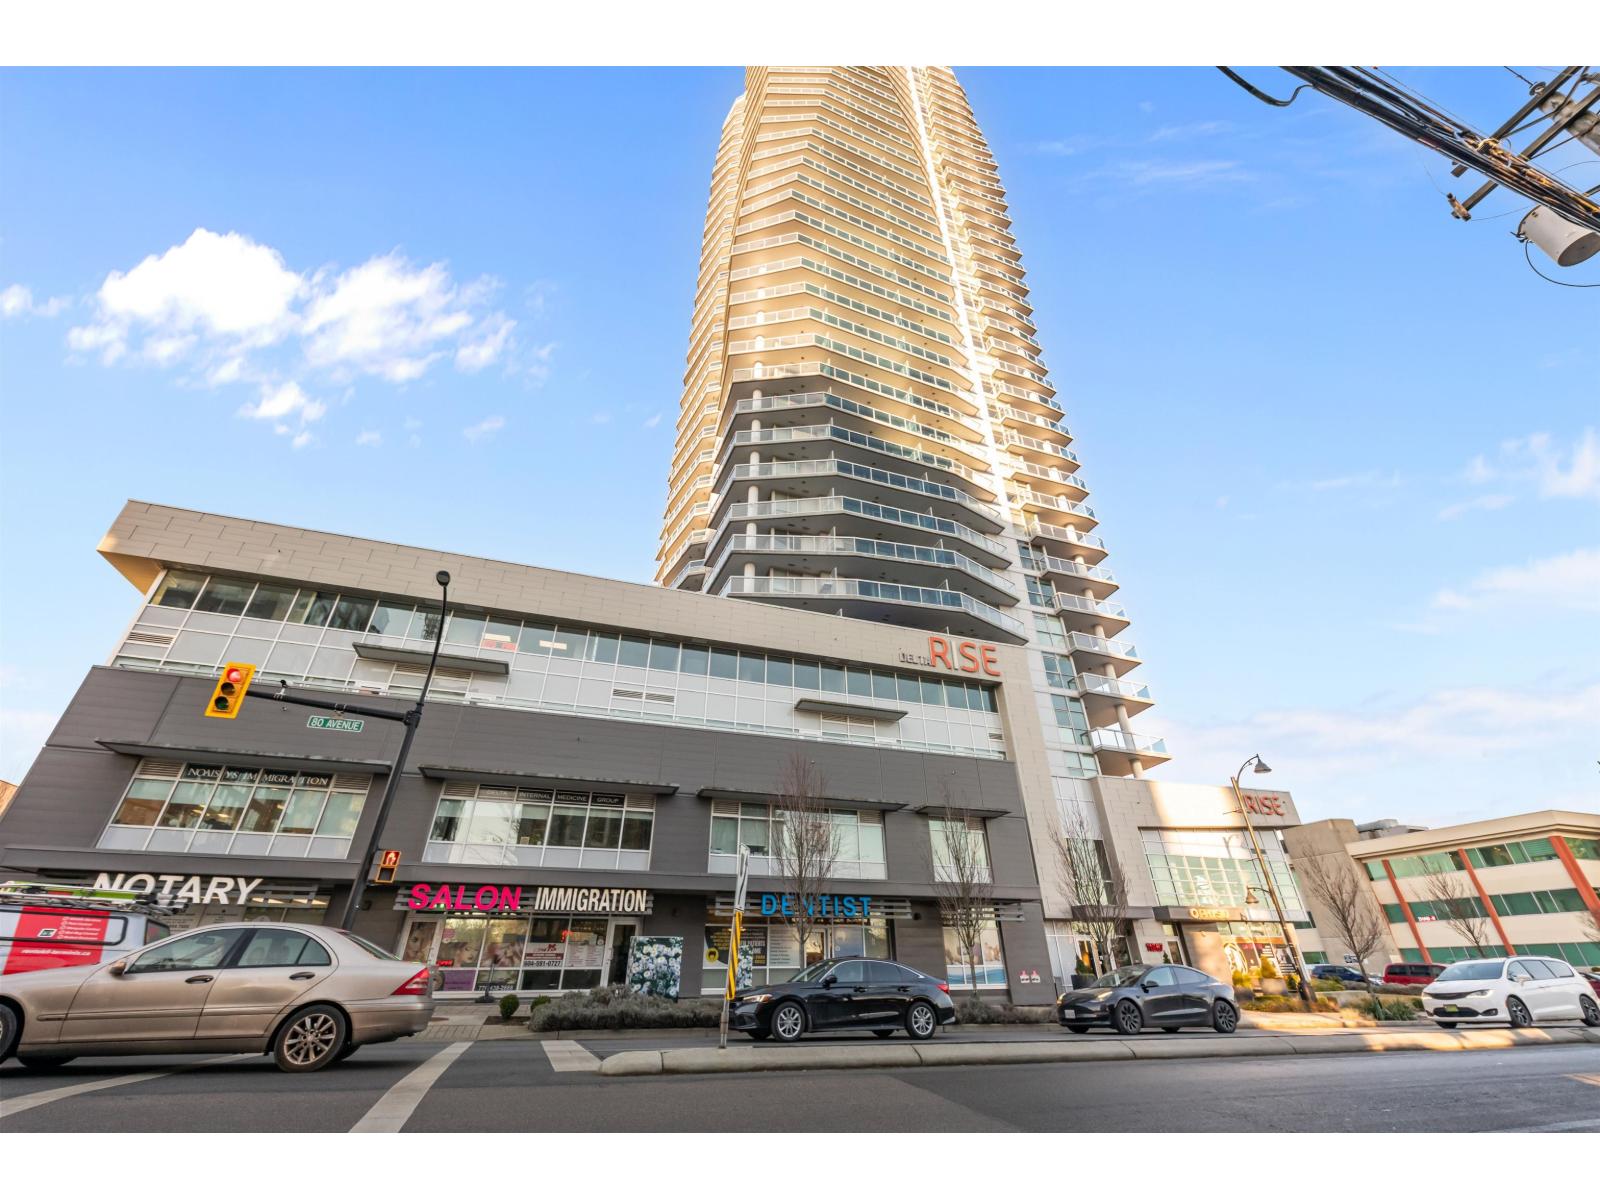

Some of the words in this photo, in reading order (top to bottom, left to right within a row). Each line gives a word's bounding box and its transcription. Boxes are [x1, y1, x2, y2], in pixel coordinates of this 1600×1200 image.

[928, 636, 1002, 676] RISE
[311, 718, 324, 727] 80
[326, 719, 360, 731] AVENUE
[519, 791, 551, 799] INTERNAL
[557, 793, 587, 802] MEDICINE
[1243, 792, 1285, 816] RISE
[92, 872, 264, 905] NOTARY
[408, 883, 522, 911] SALON
[534, 886, 647, 912] IMMIGRATION
[761, 894, 872, 918] DENTIST
